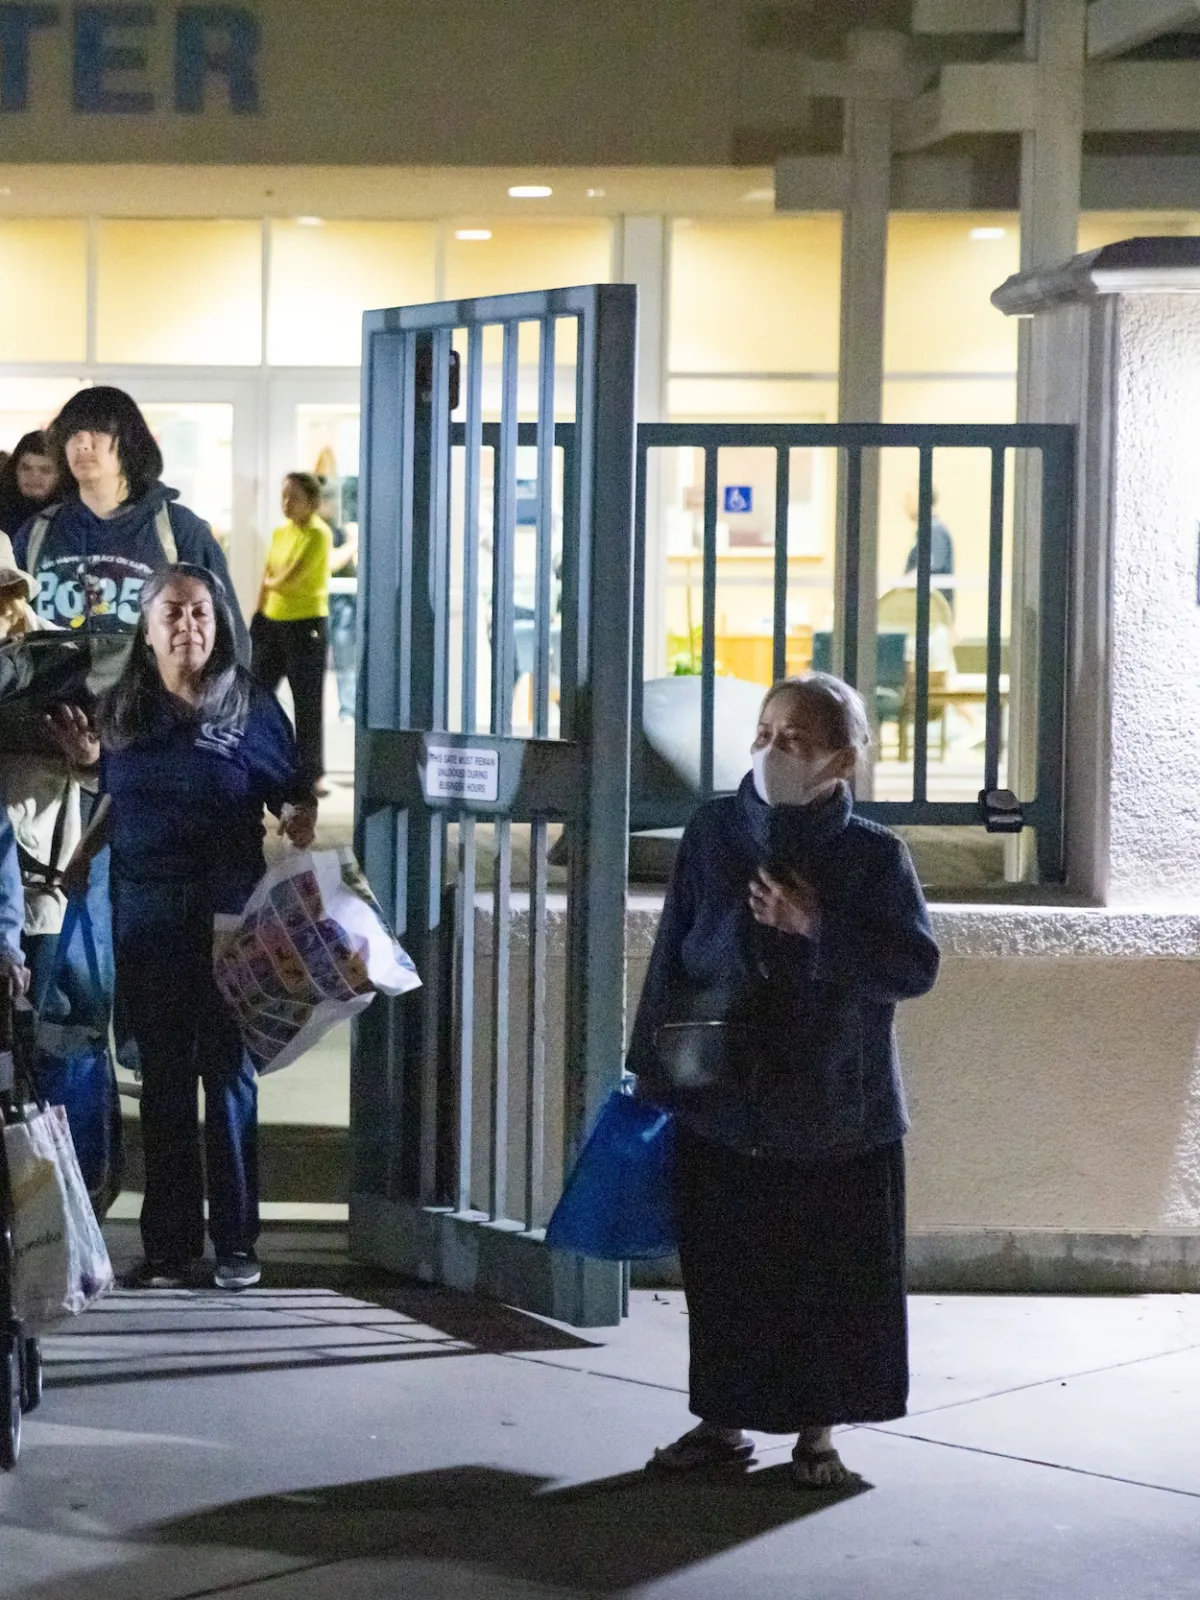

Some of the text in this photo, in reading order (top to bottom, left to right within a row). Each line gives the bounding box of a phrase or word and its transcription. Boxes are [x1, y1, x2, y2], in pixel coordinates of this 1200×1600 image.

[36, 572, 146, 625] 2025
[444, 754, 457, 764] GATE
[459, 755, 473, 765] MUST
[475, 756, 495, 766] REMAIN
[467, 769, 488, 780] DURING
[467, 782, 486, 793] HOURS
